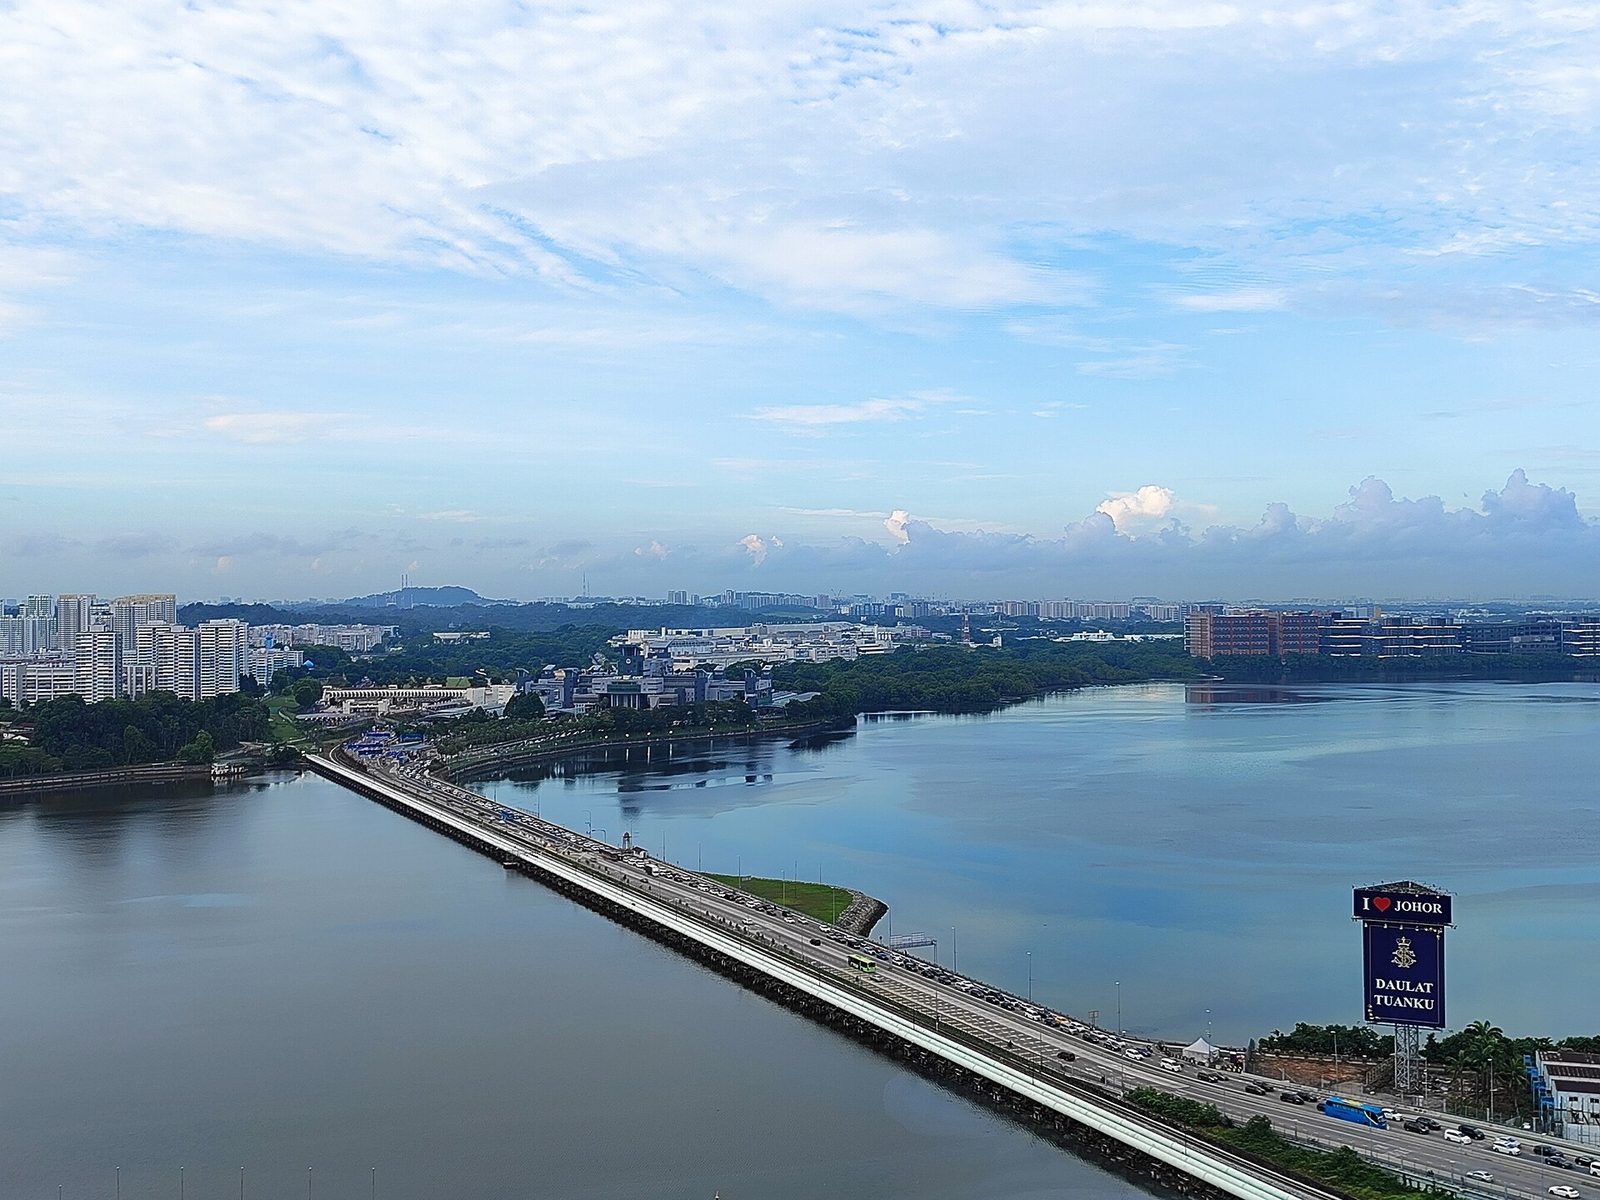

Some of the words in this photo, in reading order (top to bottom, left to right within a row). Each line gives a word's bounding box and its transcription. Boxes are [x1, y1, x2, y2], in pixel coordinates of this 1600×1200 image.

[1362, 897, 1370, 910] I
[1394, 900, 1443, 914] JOHOR
[1376, 978, 1434, 993] DAULAT
[1374, 994, 1434, 1010] TUANKU
